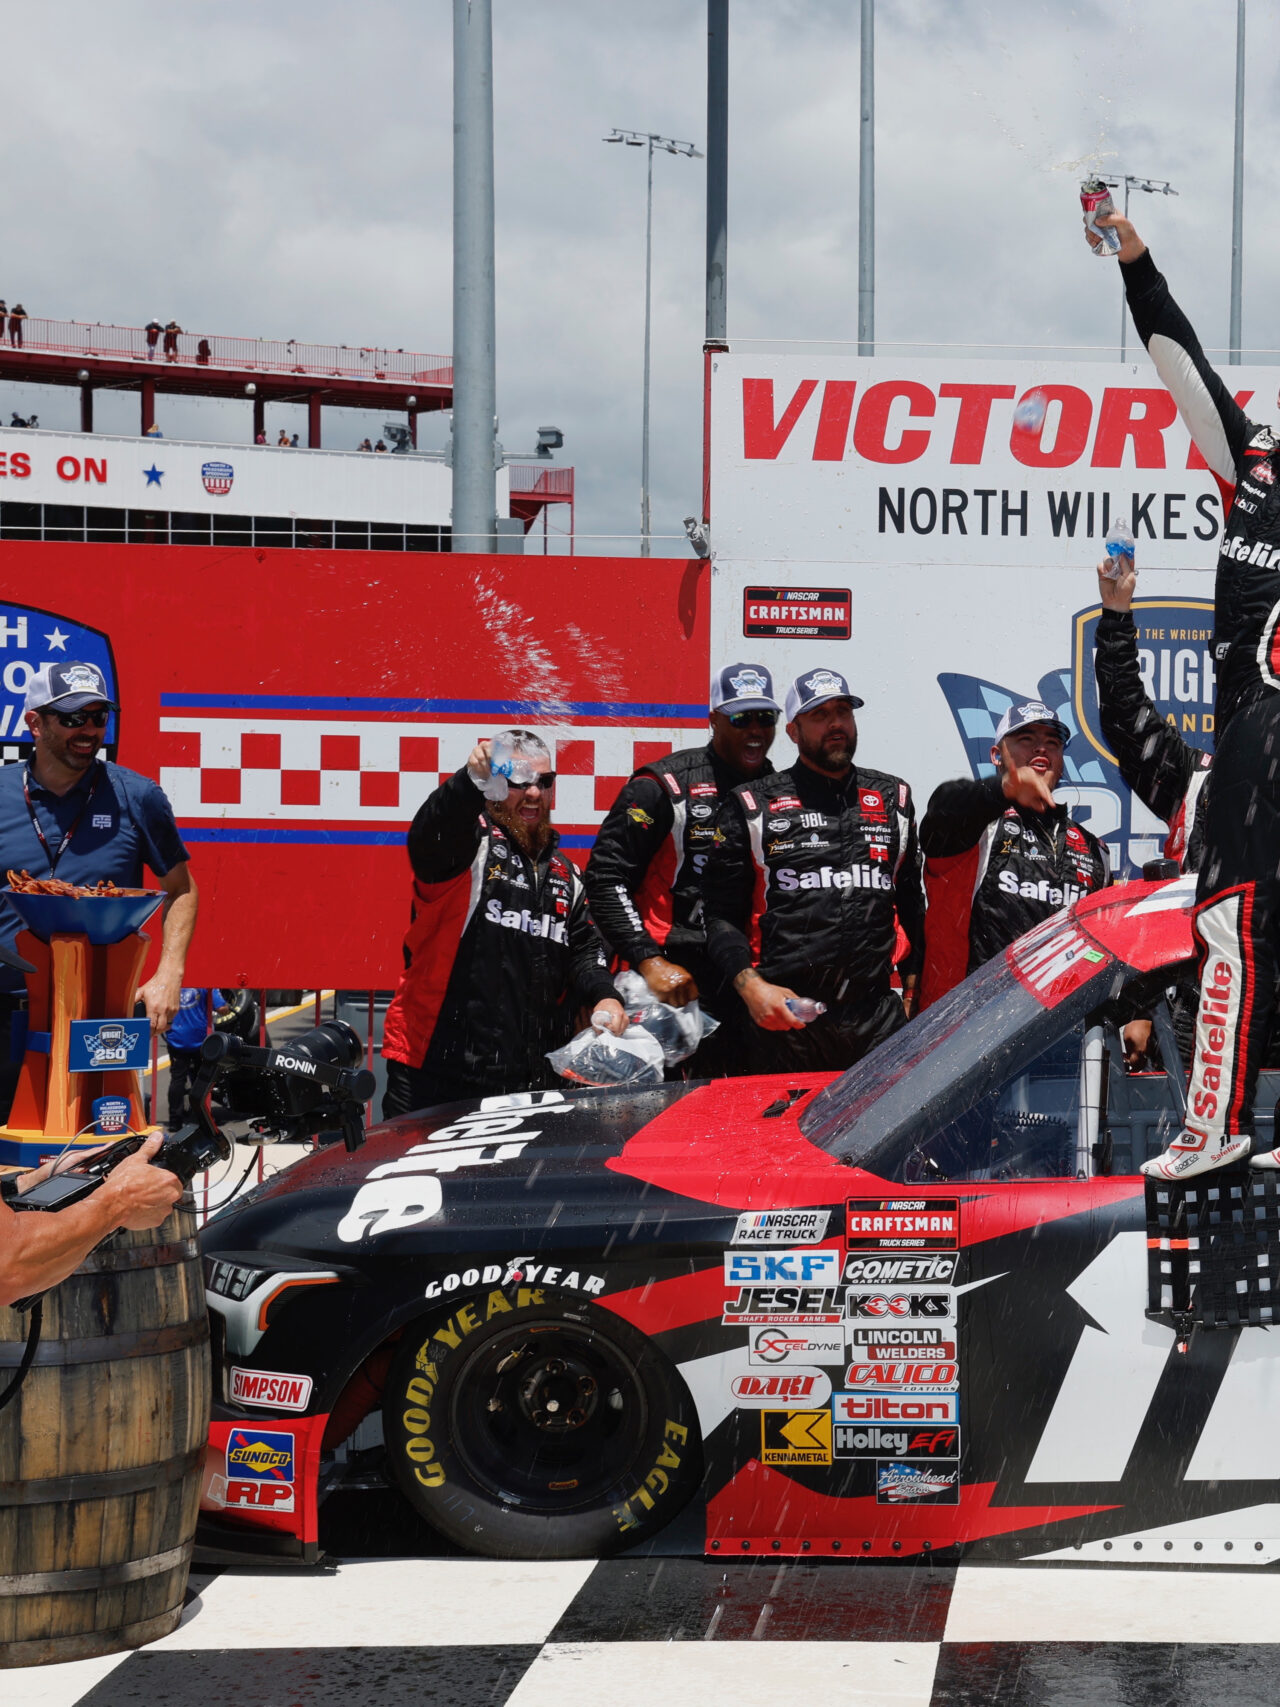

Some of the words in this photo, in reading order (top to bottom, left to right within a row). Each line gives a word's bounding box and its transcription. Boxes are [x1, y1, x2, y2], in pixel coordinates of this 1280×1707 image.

[57, 455, 108, 484] ON
[878, 487, 1028, 537] NORTH
[1047, 491, 1220, 541] WILKES
[787, 592, 819, 601] NASCAR
[749, 605, 846, 621] CRAFTSMAN
[1145, 628, 1165, 640] THE
[1170, 629, 1213, 641] WRIGHT
[777, 864, 892, 891] Safelite
[998, 870, 1088, 906] Safeli
[485, 899, 569, 947] Safelit
[1193, 960, 1233, 1120] Safelite
[95, 1048, 126, 1060] 250
[275, 1053, 317, 1075] RONIN
[891, 1201, 926, 1211] NASCAR
[766, 1215, 817, 1227] NASCAR
[851, 1216, 953, 1232] CRAFTSMAN
[739, 1229, 774, 1240] RACE
[776, 1229, 818, 1240] TRUCK
[879, 1238, 902, 1247] TRUCK
[901, 1238, 926, 1247] SERIES
[730, 1255, 834, 1281] SKF
[846, 1257, 954, 1280] COMETIC
[425, 1260, 606, 1299] GOODYEAR
[725, 1287, 844, 1314] JESEL
[738, 1315, 764, 1323] SHAFT
[767, 1315, 800, 1323] ROCKER
[803, 1315, 827, 1323] ARMS
[858, 1330, 938, 1344] LINCOLN
[875, 1348, 946, 1360] WELDERS
[848, 1364, 956, 1385] CALICO
[233, 1373, 304, 1404] SIMPSON
[841, 1397, 949, 1419] tilton
[836, 1428, 908, 1455] Holley
[232, 1450, 289, 1465] SUNOCO
[764, 1452, 829, 1463] KENNAMETAL
